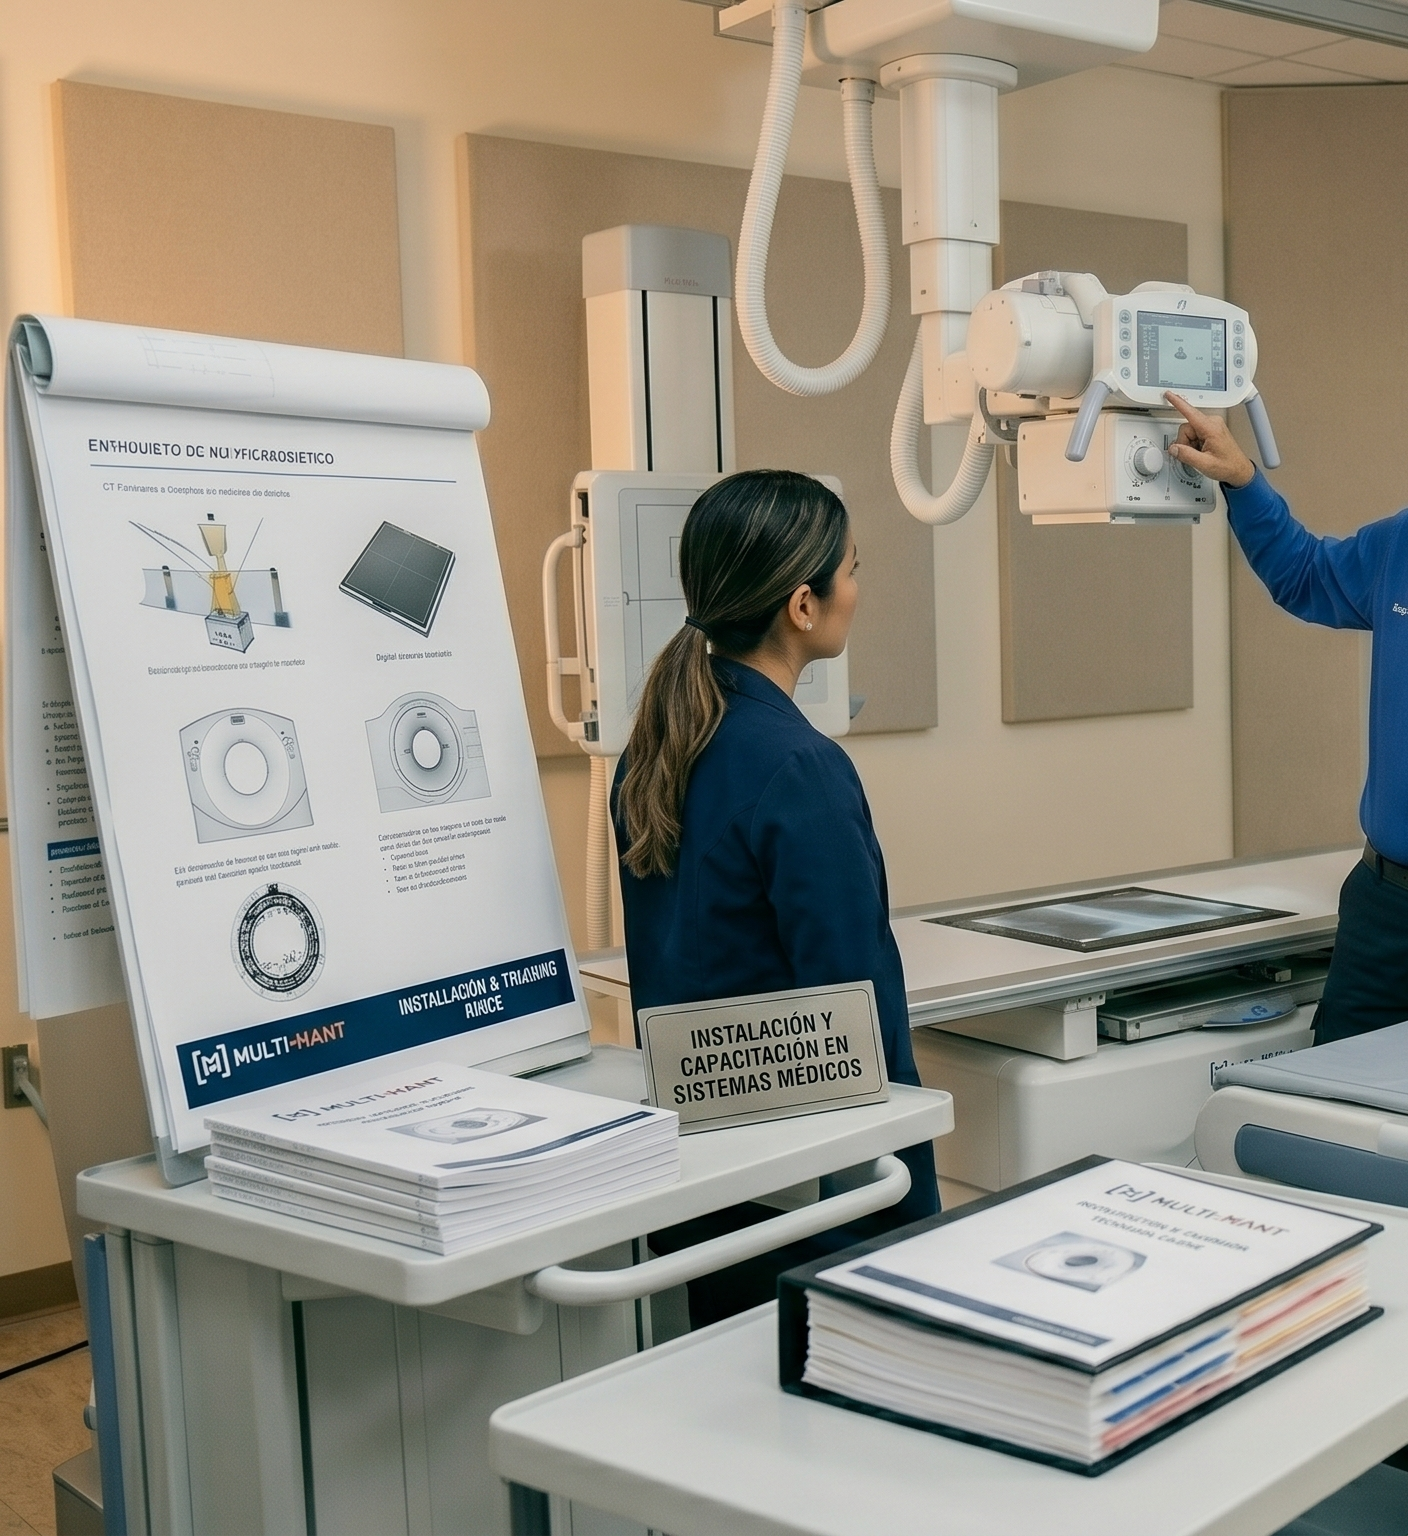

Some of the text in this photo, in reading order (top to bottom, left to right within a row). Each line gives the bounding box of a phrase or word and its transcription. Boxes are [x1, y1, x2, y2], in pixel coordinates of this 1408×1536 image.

[490, 976, 500, 991] &
[690, 1010, 833, 1049] INSTALACIÓN Y
[680, 1035, 849, 1077] CAPACITACIÓN EN
[673, 1058, 863, 1105] SISTEMAS MÉDICOS
